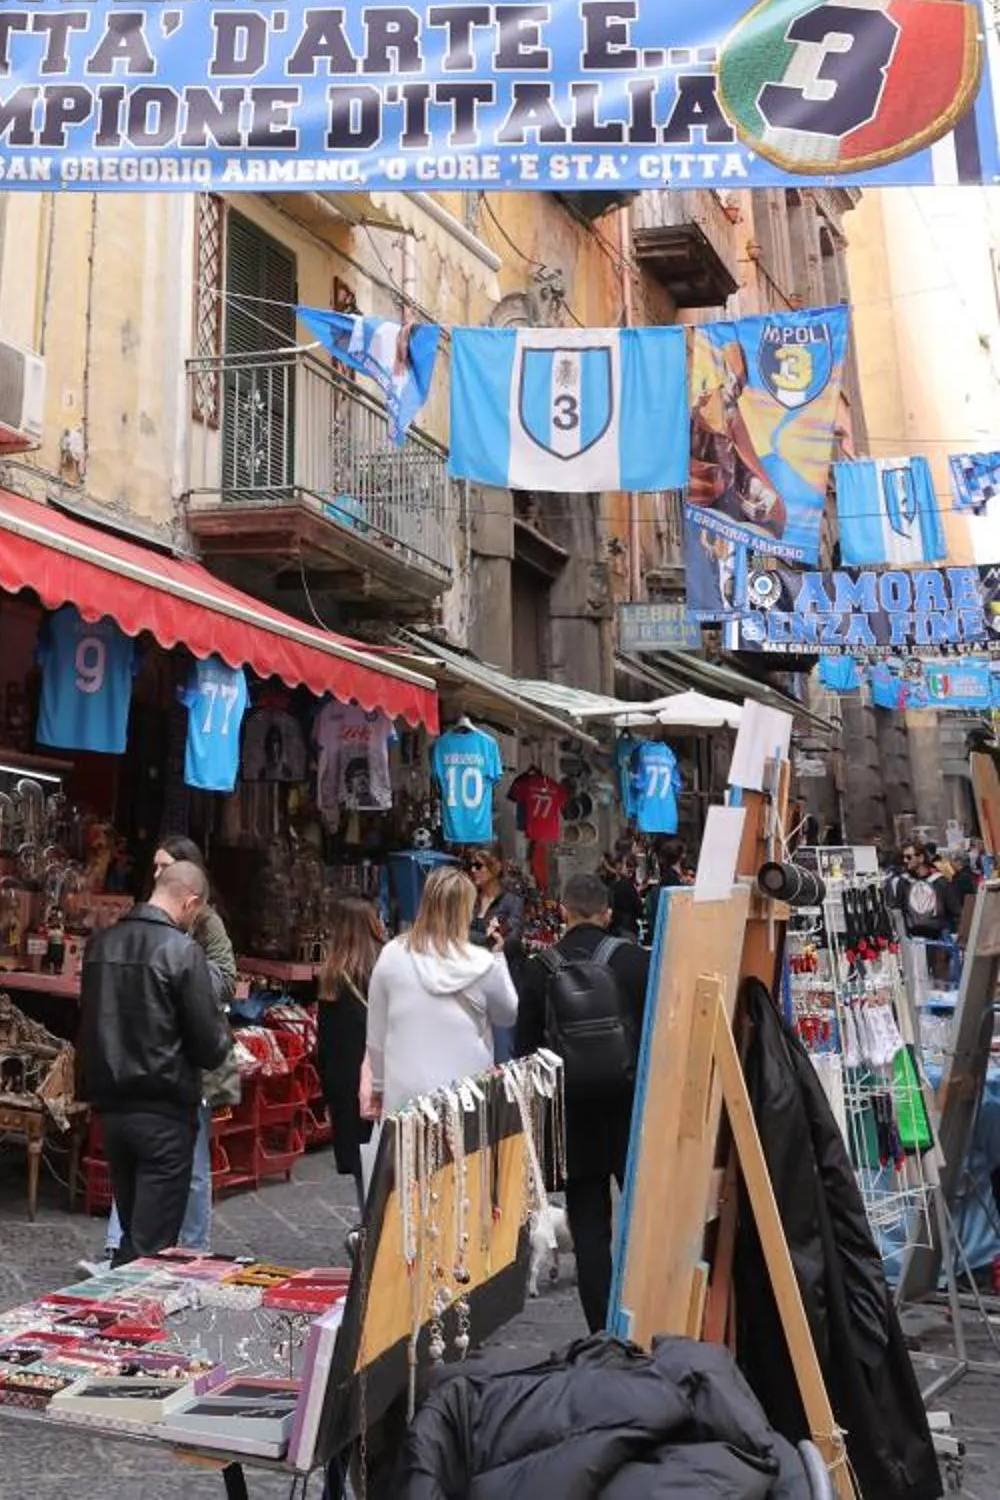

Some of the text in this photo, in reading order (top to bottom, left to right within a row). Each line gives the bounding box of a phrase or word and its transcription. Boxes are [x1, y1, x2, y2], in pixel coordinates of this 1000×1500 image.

[208, 3, 552, 77] D'ARTE
[579, 0, 719, 72] E...
[755, 4, 902, 137] 3
[325, 73, 739, 150] D'ITALIA
[60, 156, 214, 182] GREGORIO
[222, 157, 367, 184] ARMENO,
[415, 155, 501, 181] CORE
[549, 153, 628, 180] STA'
[639, 150, 757, 180] CITTA'
[771, 346, 813, 392] 3
[552, 394, 579, 431] 3
[796, 567, 984, 613] AMORE
[742, 609, 988, 646] SENZA FINE
[74, 636, 106, 693] 9
[200, 681, 239, 736] 77
[445, 765, 484, 809] 10
[645, 764, 672, 800] 77
[532, 792, 554, 819] 77
